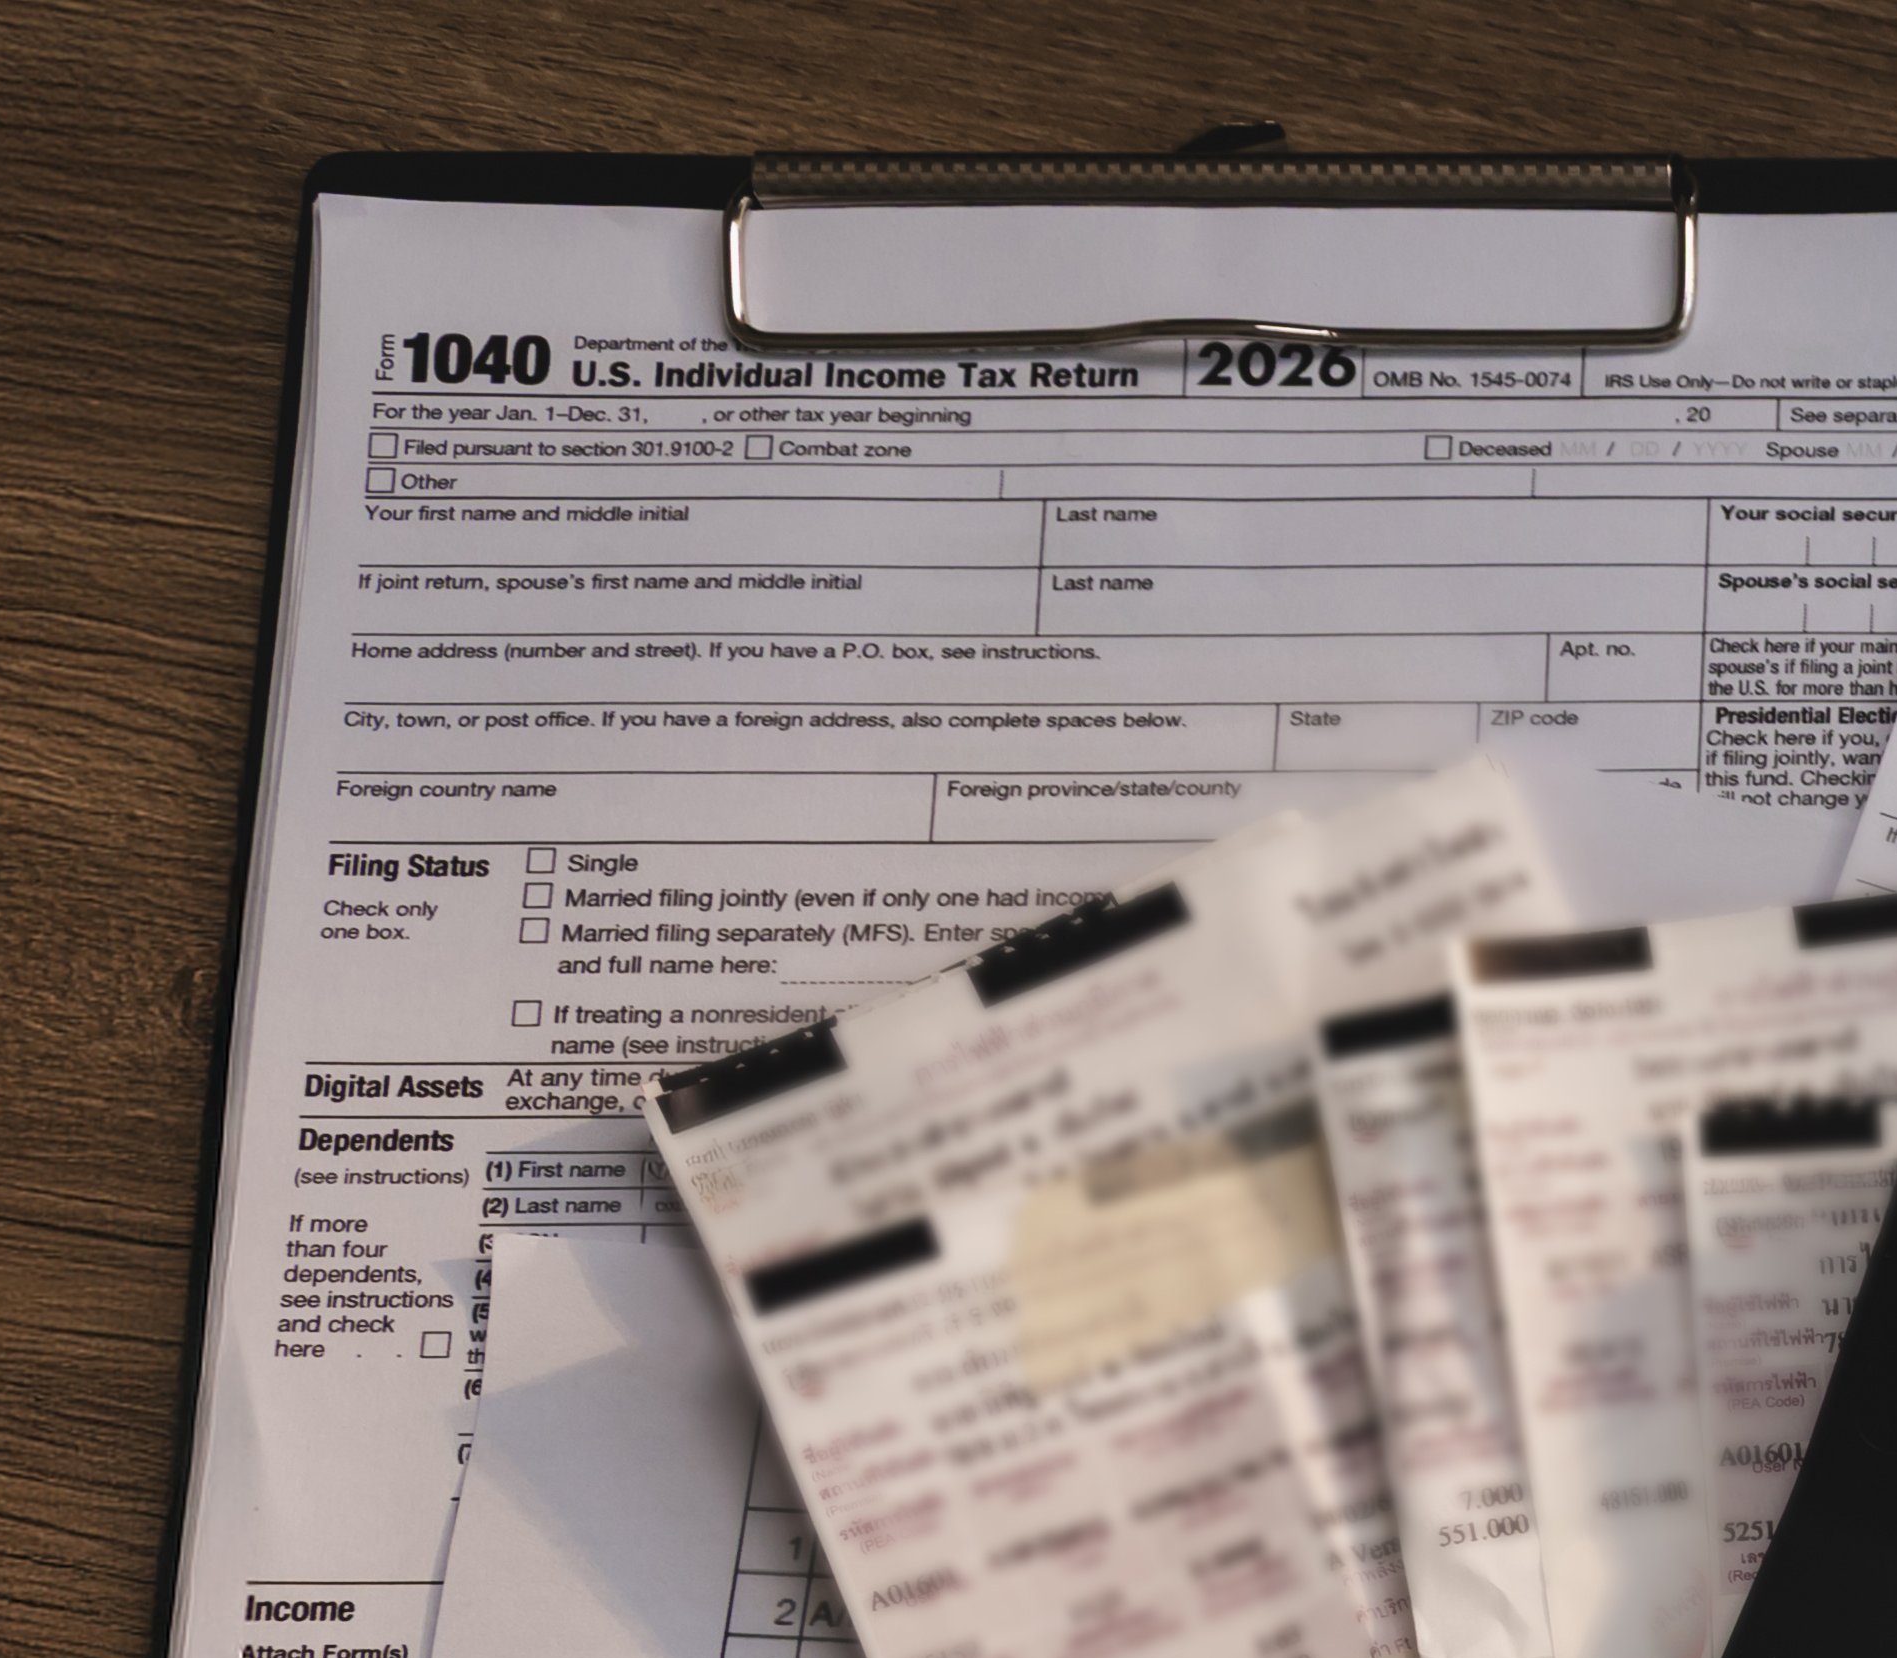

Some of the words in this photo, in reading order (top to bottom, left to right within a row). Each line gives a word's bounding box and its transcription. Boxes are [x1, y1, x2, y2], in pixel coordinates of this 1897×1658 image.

[375, 334, 395, 381] Form
[403, 332, 550, 385] 1040
[1198, 340, 1358, 388] 2026
[572, 360, 641, 388] U.S.
[654, 361, 813, 388] Individual
[824, 360, 946, 389] Income
[957, 362, 1016, 389] Tax
[1029, 361, 1139, 388] Return
[1373, 371, 1423, 388] OMB
[1429, 371, 1461, 388] No.
[1471, 371, 1571, 388] 1545-0074
[365, 505, 413, 521] Your
[418, 505, 455, 521] first
[461, 509, 517, 521] name
[522, 506, 560, 521] and
[566, 506, 633, 522] middle
[639, 506, 689, 521] initial
[1056, 506, 1097, 522] Last
[1103, 509, 1158, 522] name
[336, 780, 413, 801] Foreign
[419, 782, 496, 801] country
[501, 784, 557, 797] name
[328, 853, 399, 882] Filing
[407, 854, 490, 878] Status
[567, 854, 639, 877] Single
[323, 899, 389, 917] Check
[395, 901, 438, 921] only
[320, 927, 360, 940] one
[366, 924, 410, 940] box.
[304, 1074, 390, 1103] Digital
[397, 1075, 484, 1098] Assets
[298, 1128, 454, 1156] Dependents
[294, 1168, 338, 1188] (see
[344, 1168, 470, 1188] instructions)
[1438, 1513, 1530, 1548] 551.000
[245, 1595, 355, 1622] Income
